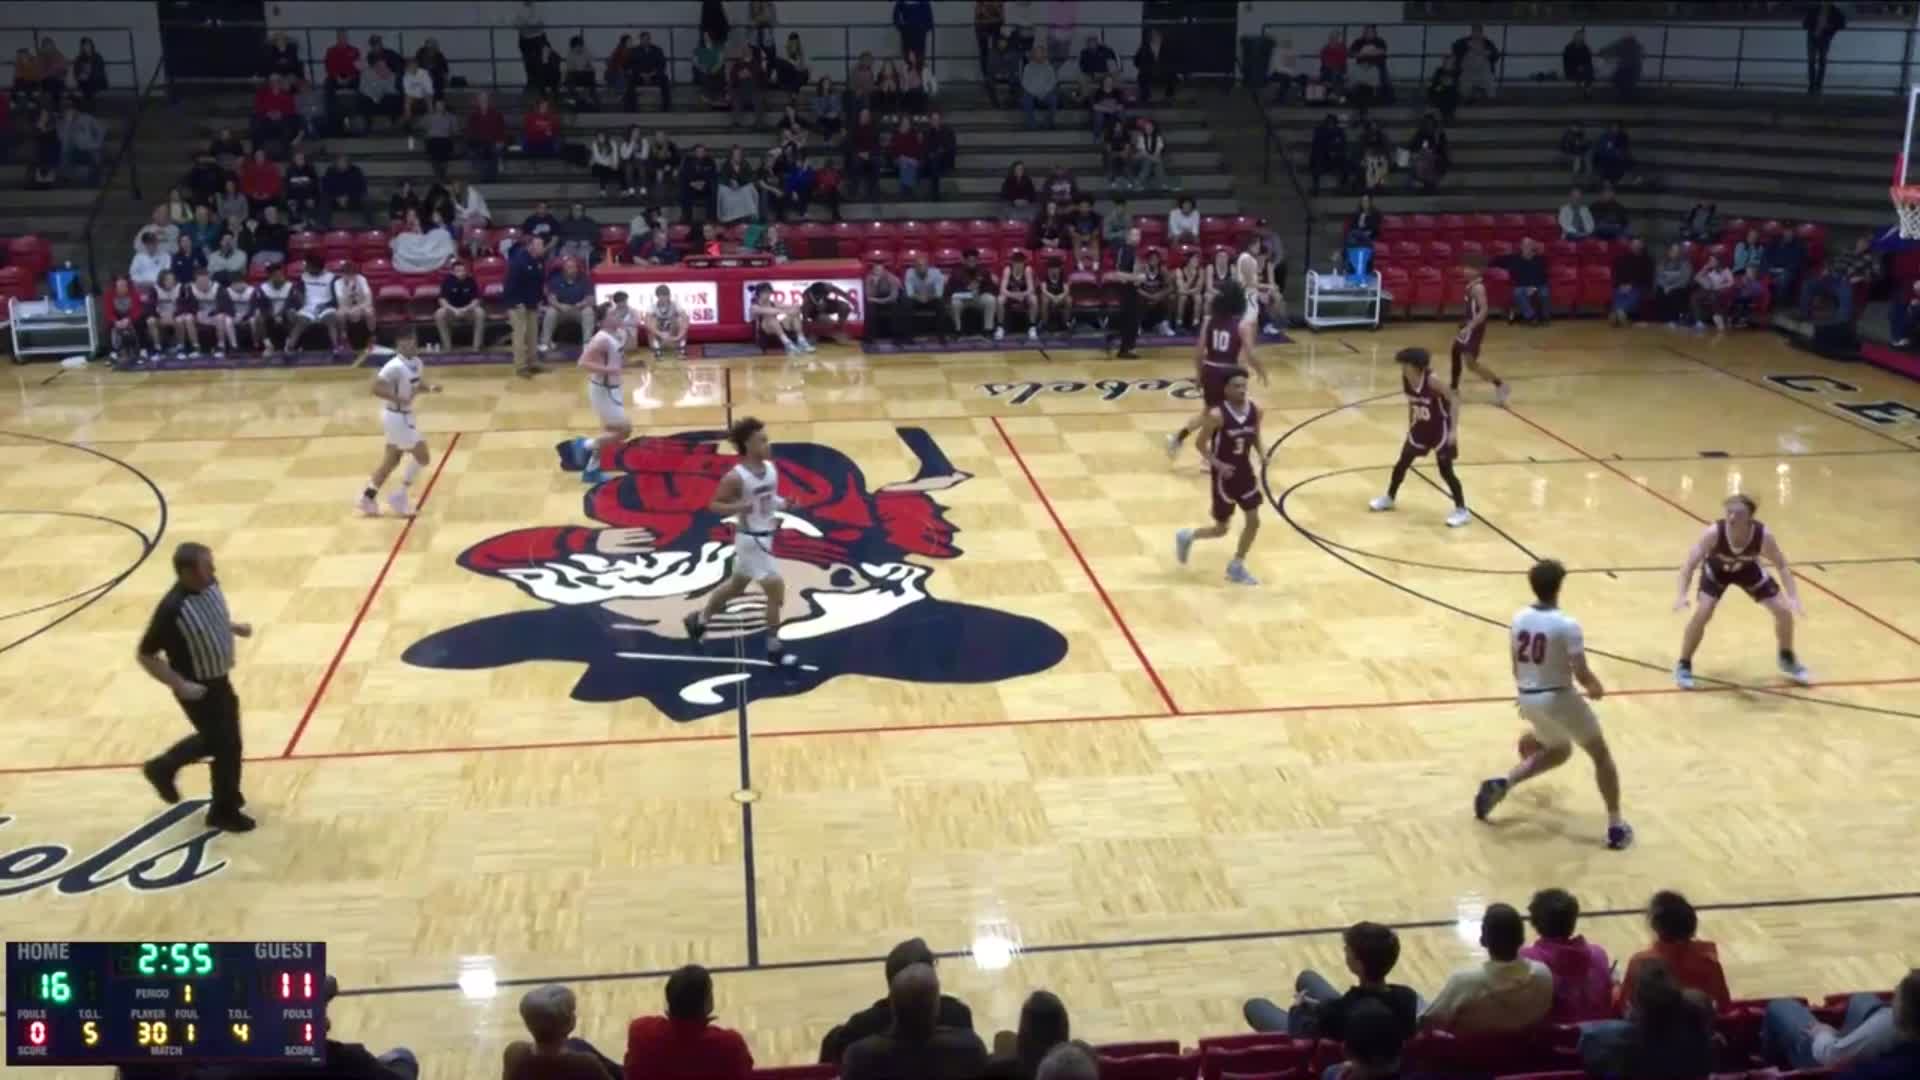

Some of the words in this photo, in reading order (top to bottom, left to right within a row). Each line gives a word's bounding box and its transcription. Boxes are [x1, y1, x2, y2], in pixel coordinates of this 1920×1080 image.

[1213, 329, 1231, 351] 10
[1517, 629, 1547, 664] 20
[0, 798, 228, 896] els
